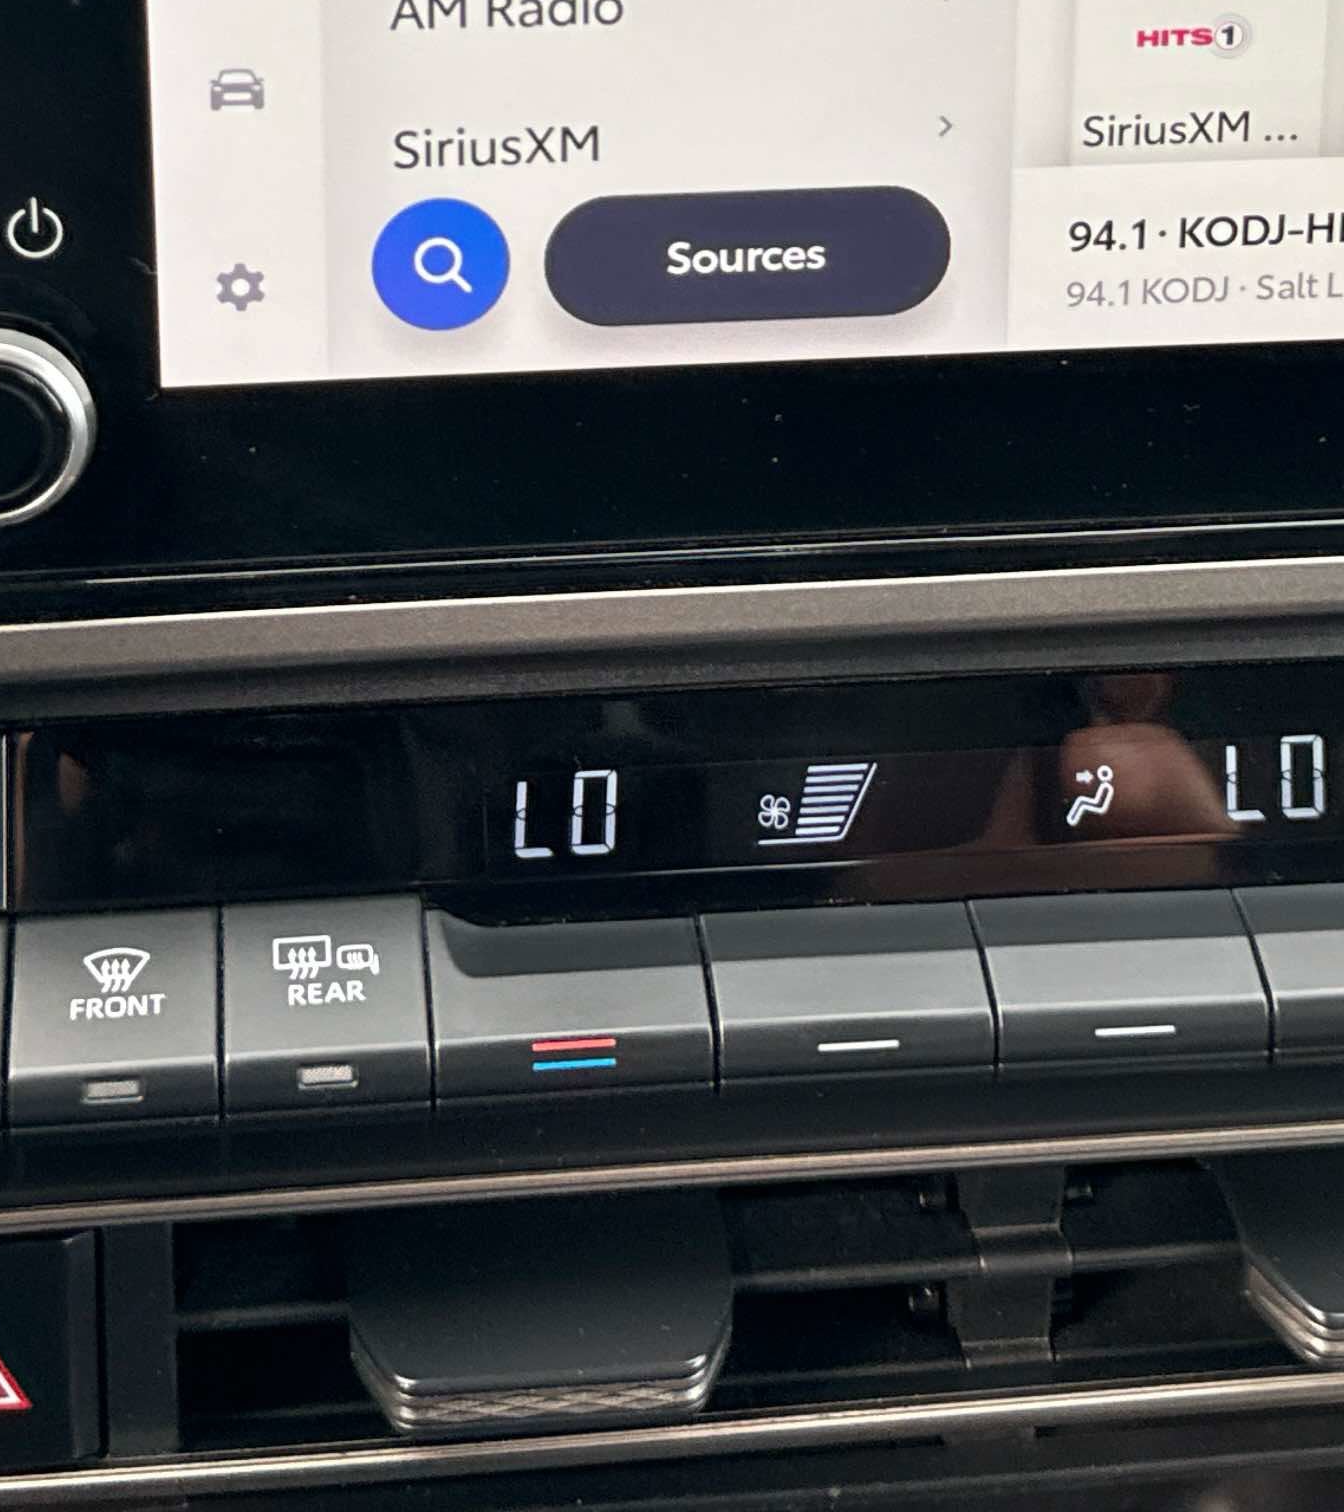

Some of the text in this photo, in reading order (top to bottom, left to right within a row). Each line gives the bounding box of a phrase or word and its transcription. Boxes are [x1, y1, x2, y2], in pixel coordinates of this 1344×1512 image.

[1137, 28, 1213, 47] HITS
[1084, 111, 1249, 147] SiriusXM
[395, 126, 598, 169] SiriusXM
[1070, 219, 1145, 251] 94.1
[667, 242, 826, 275] Sources
[1067, 280, 1128, 307] 94.1
[1143, 276, 1229, 304] KODJ
[1256, 272, 1318, 300] Salt
[69, 992, 166, 1020] FRONT
[287, 980, 366, 1007] REAR
